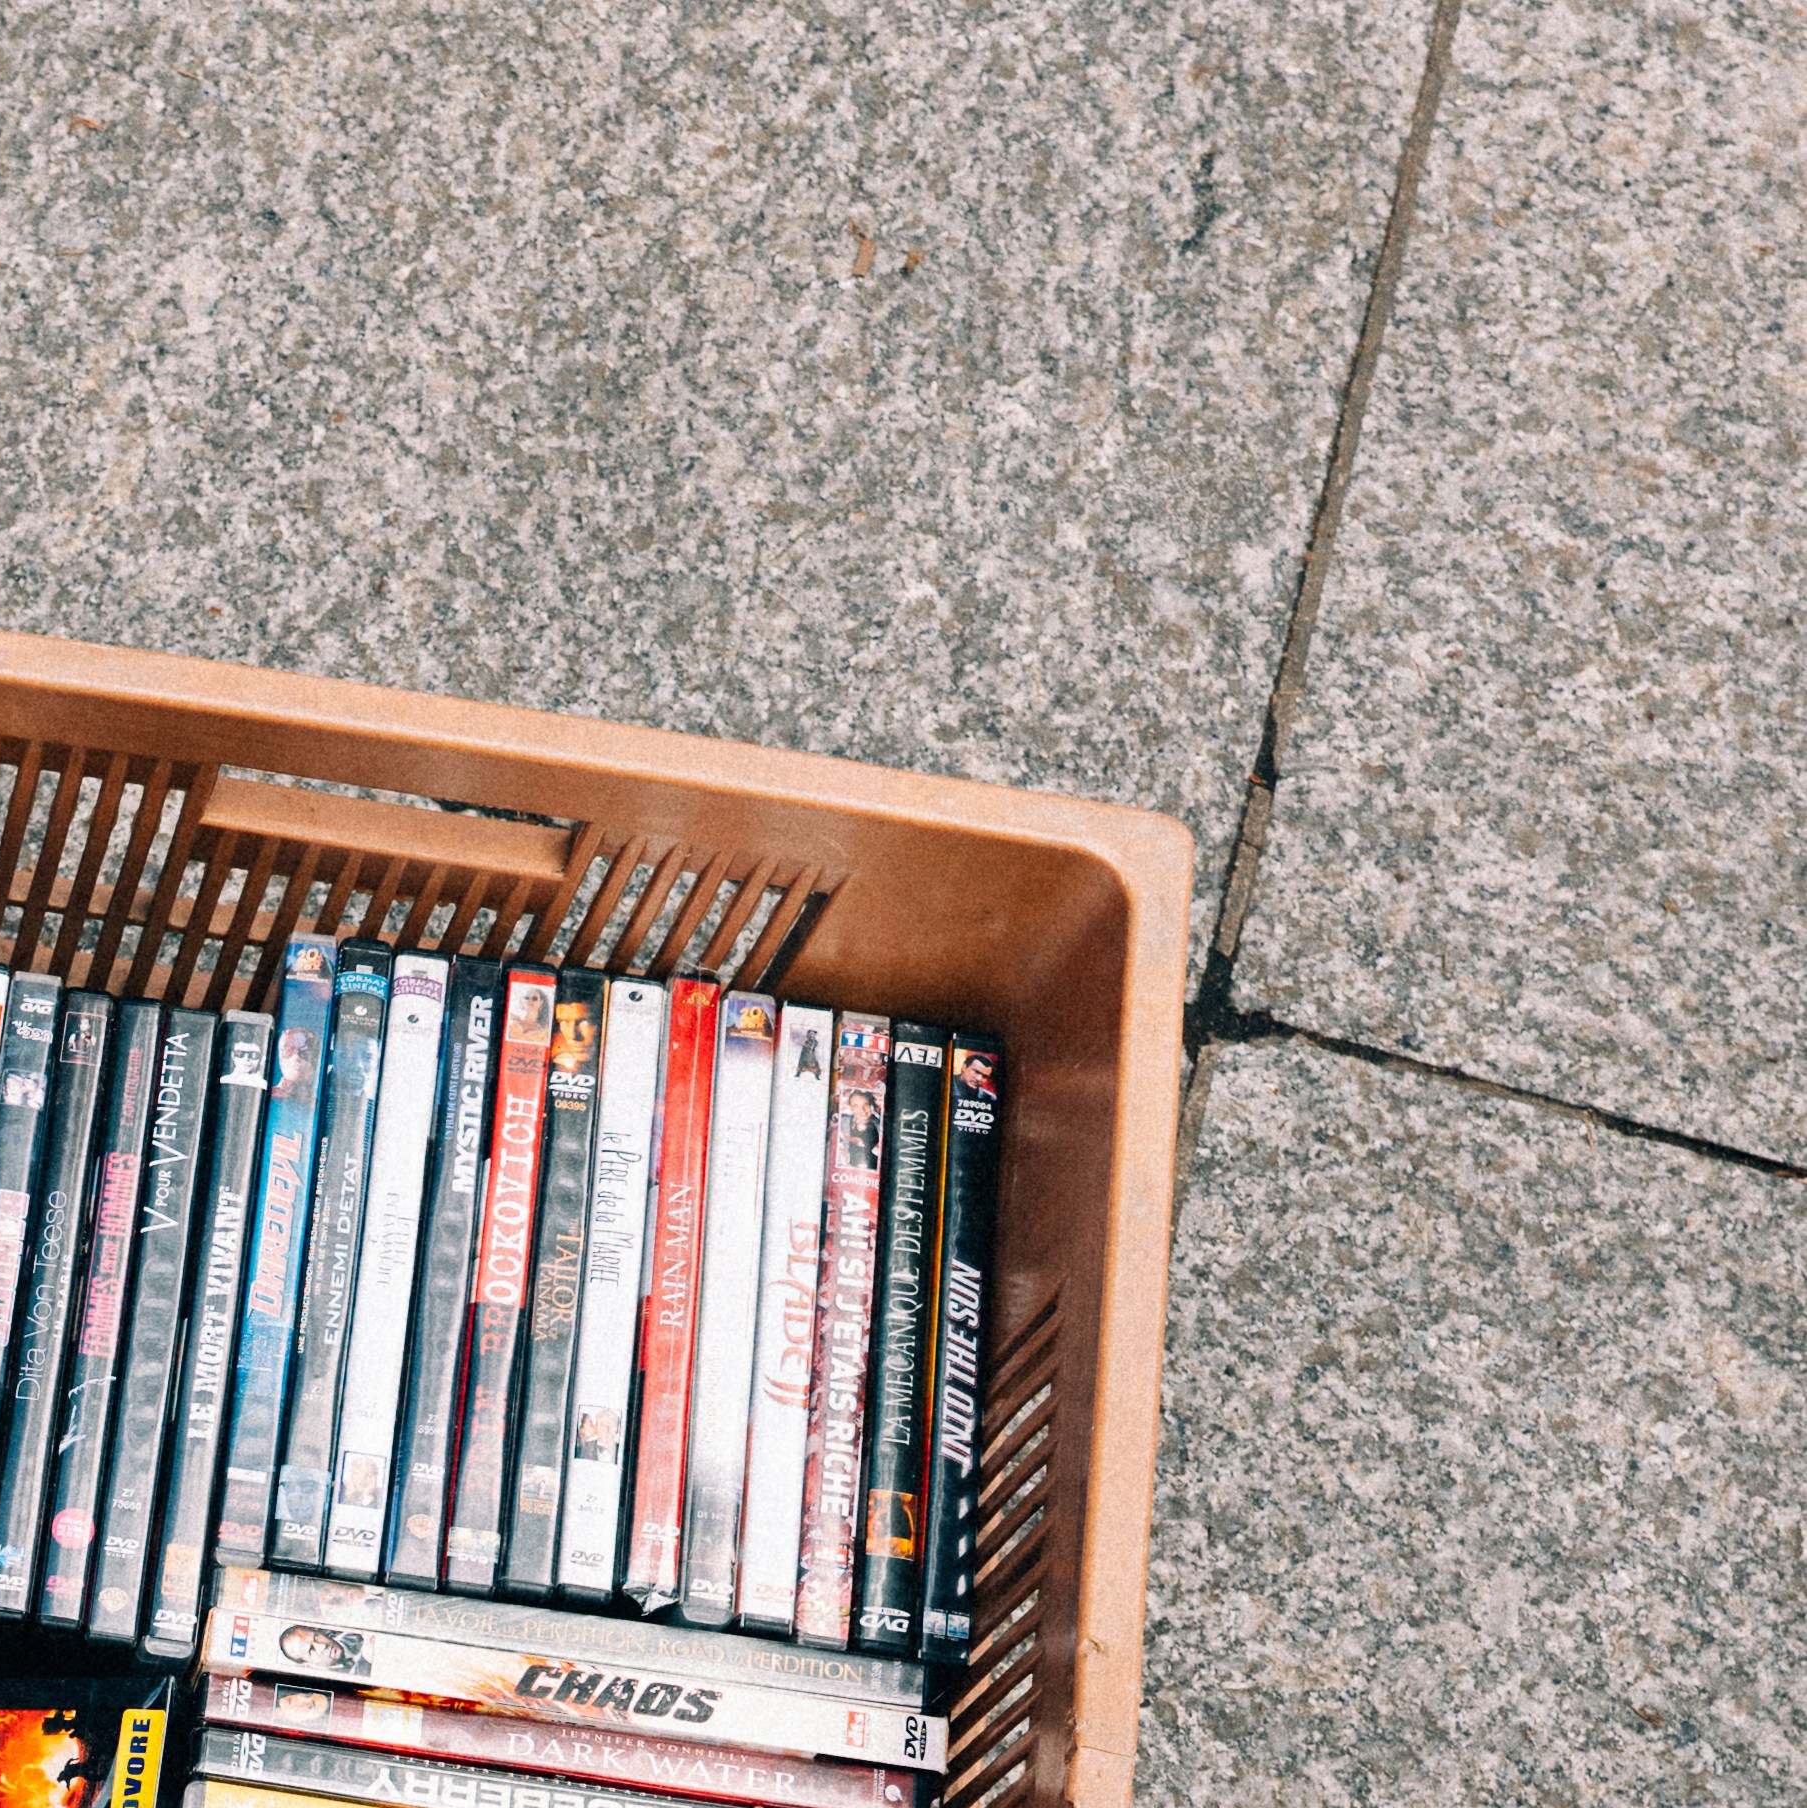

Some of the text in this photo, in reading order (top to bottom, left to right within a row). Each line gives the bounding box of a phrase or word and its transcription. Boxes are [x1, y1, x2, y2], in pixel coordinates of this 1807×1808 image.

[141, 1030, 205, 1238] V POUR VENDETTA
[450, 995, 493, 1193] MYSTIC RIVER
[13, 1188, 70, 1401] Dita Von Teese
[52, 1252, 73, 1338] IN PARIS
[187, 1184, 245, 1440] LE MORT VIVANT
[323, 1150, 361, 1345] ENNEMI D'ETAT
[658, 1182, 693, 1327] RAIN MAN
[822, 1193, 866, 1515] AH! SI J'ETAIS RICHE
[936, 1259, 984, 1463] INTO THE SUN
[229, 1614, 252, 1658] TF1
[512, 1660, 725, 1727] CHAOS
[505, 1730, 798, 1800] DARK WATER
[901, 1715, 922, 1759] DVD
